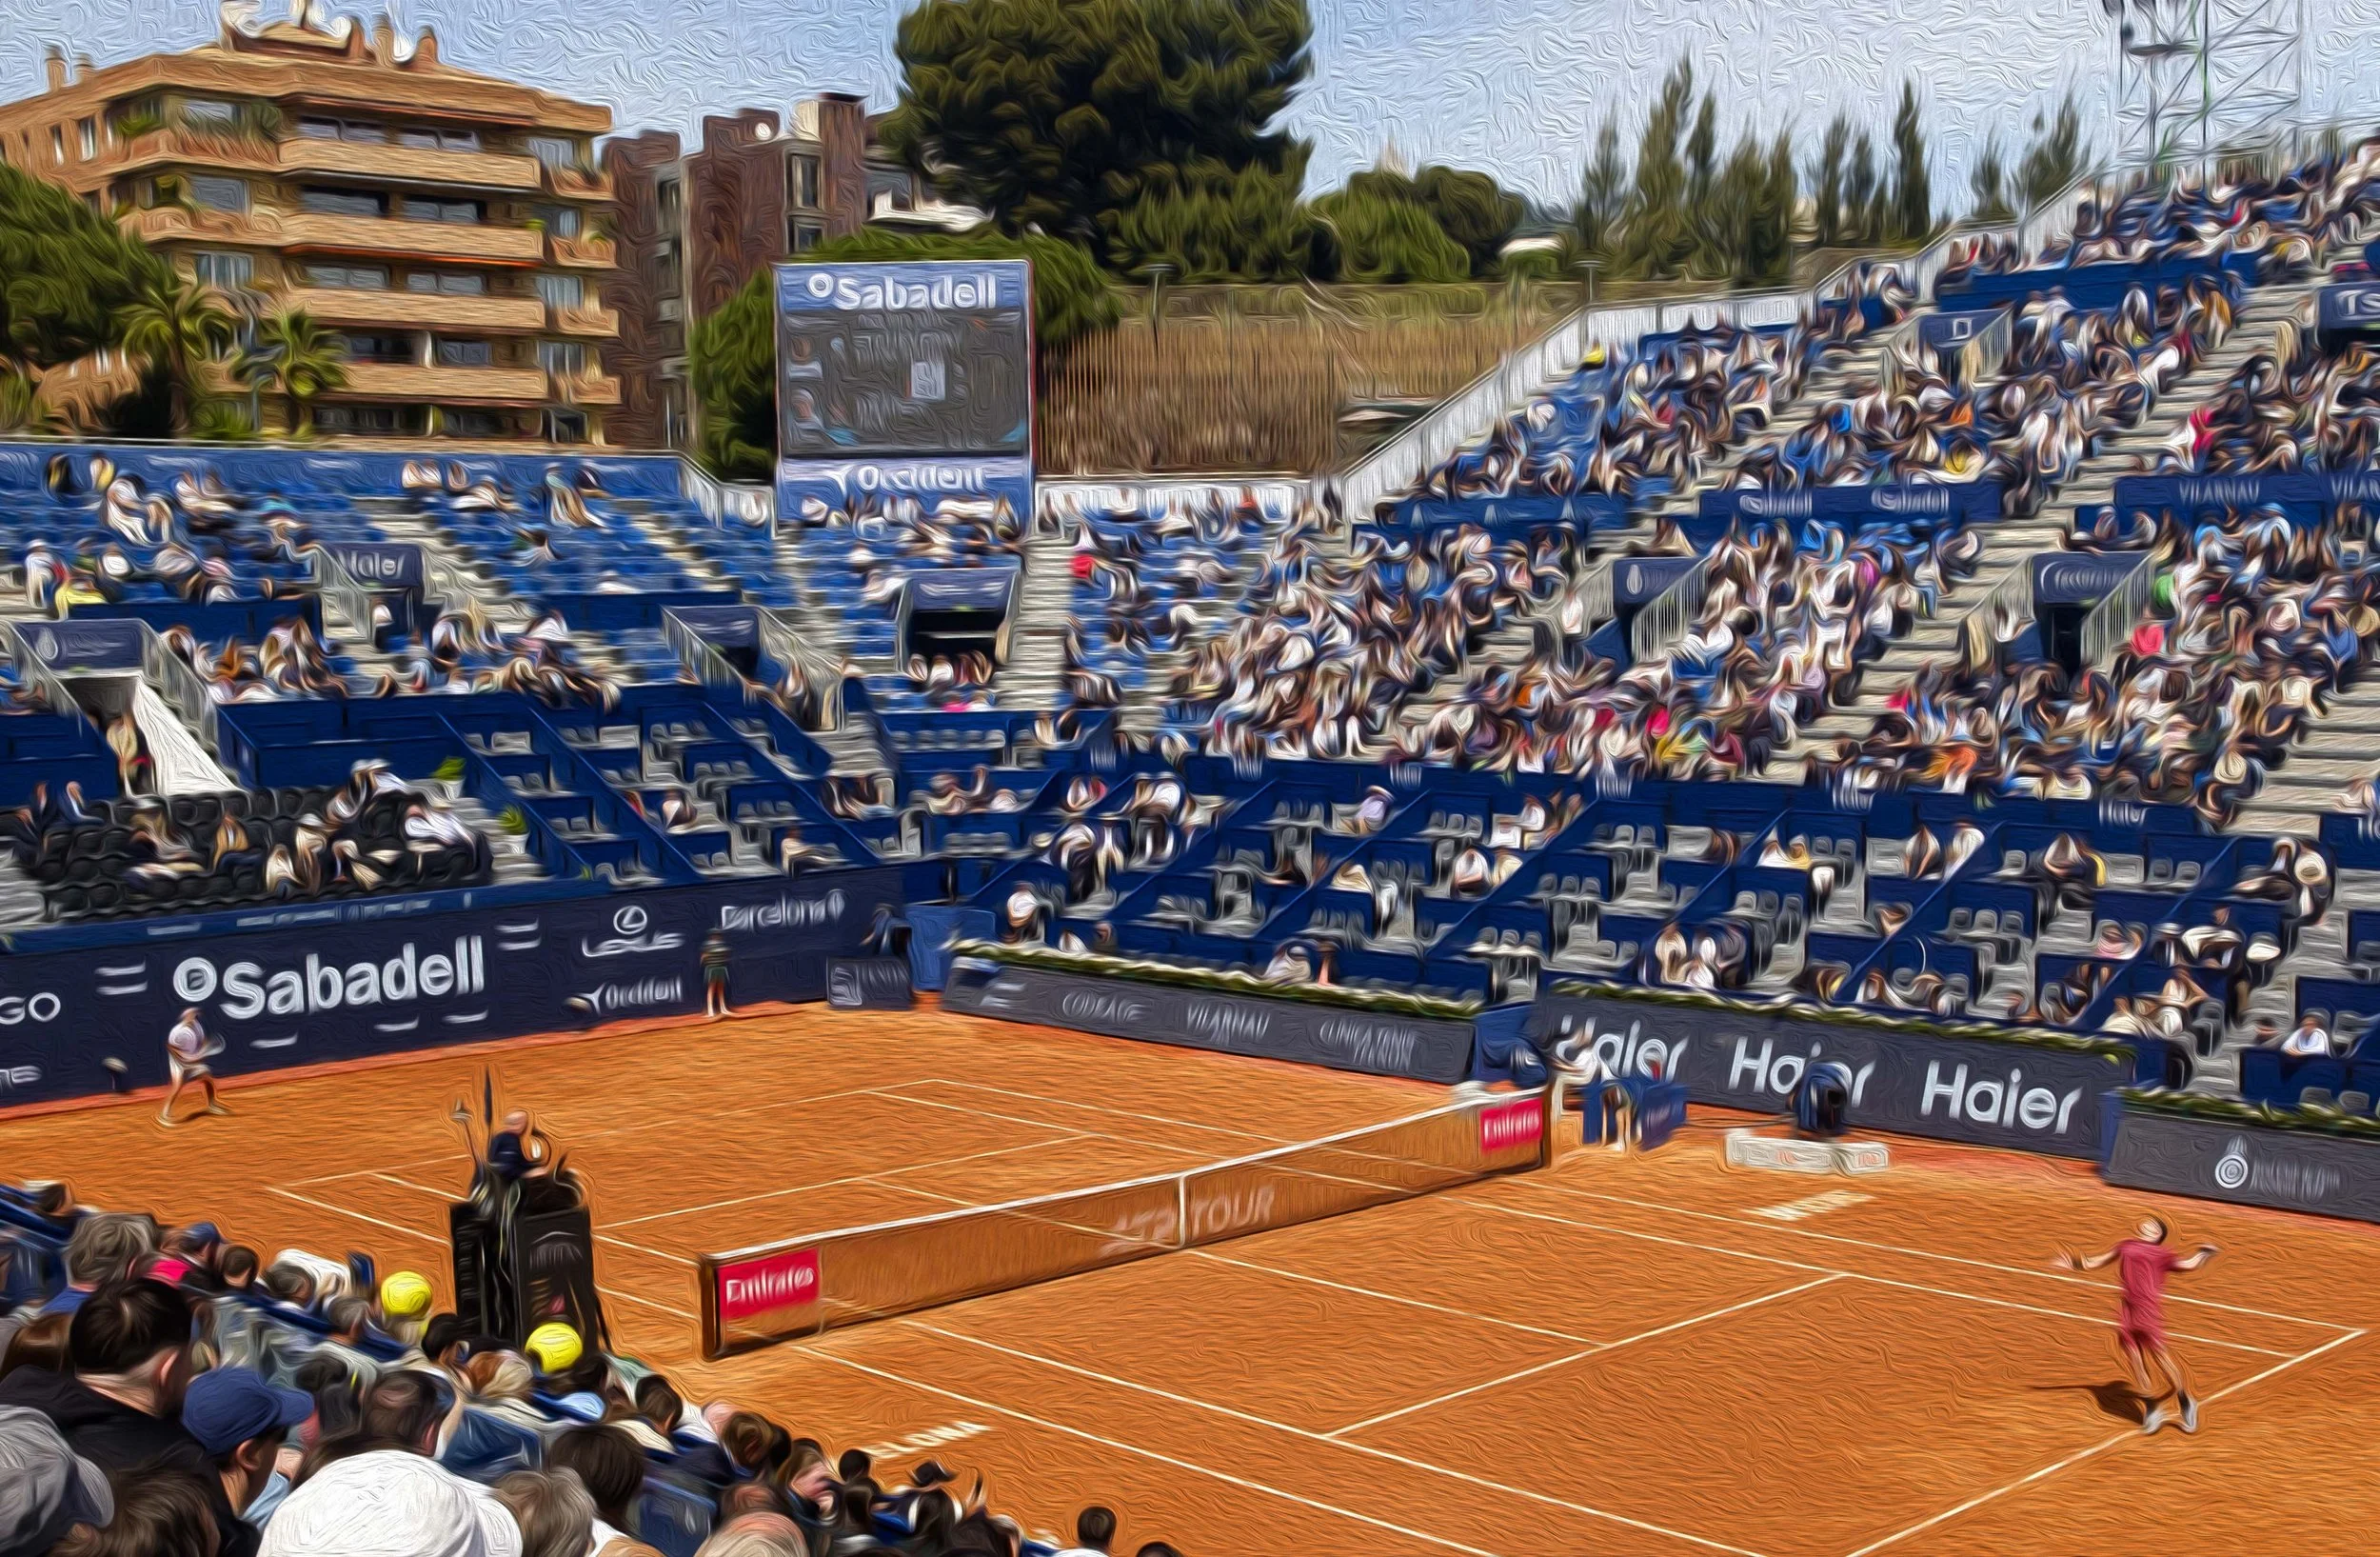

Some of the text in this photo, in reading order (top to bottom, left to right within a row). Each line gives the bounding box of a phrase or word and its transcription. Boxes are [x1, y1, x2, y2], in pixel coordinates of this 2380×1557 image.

[832, 275, 997, 309] Sabadell
[220, 935, 484, 1019] Sabadell
[1728, 1036, 1876, 1108] Har
[1920, 1060, 2083, 1134] Haier
